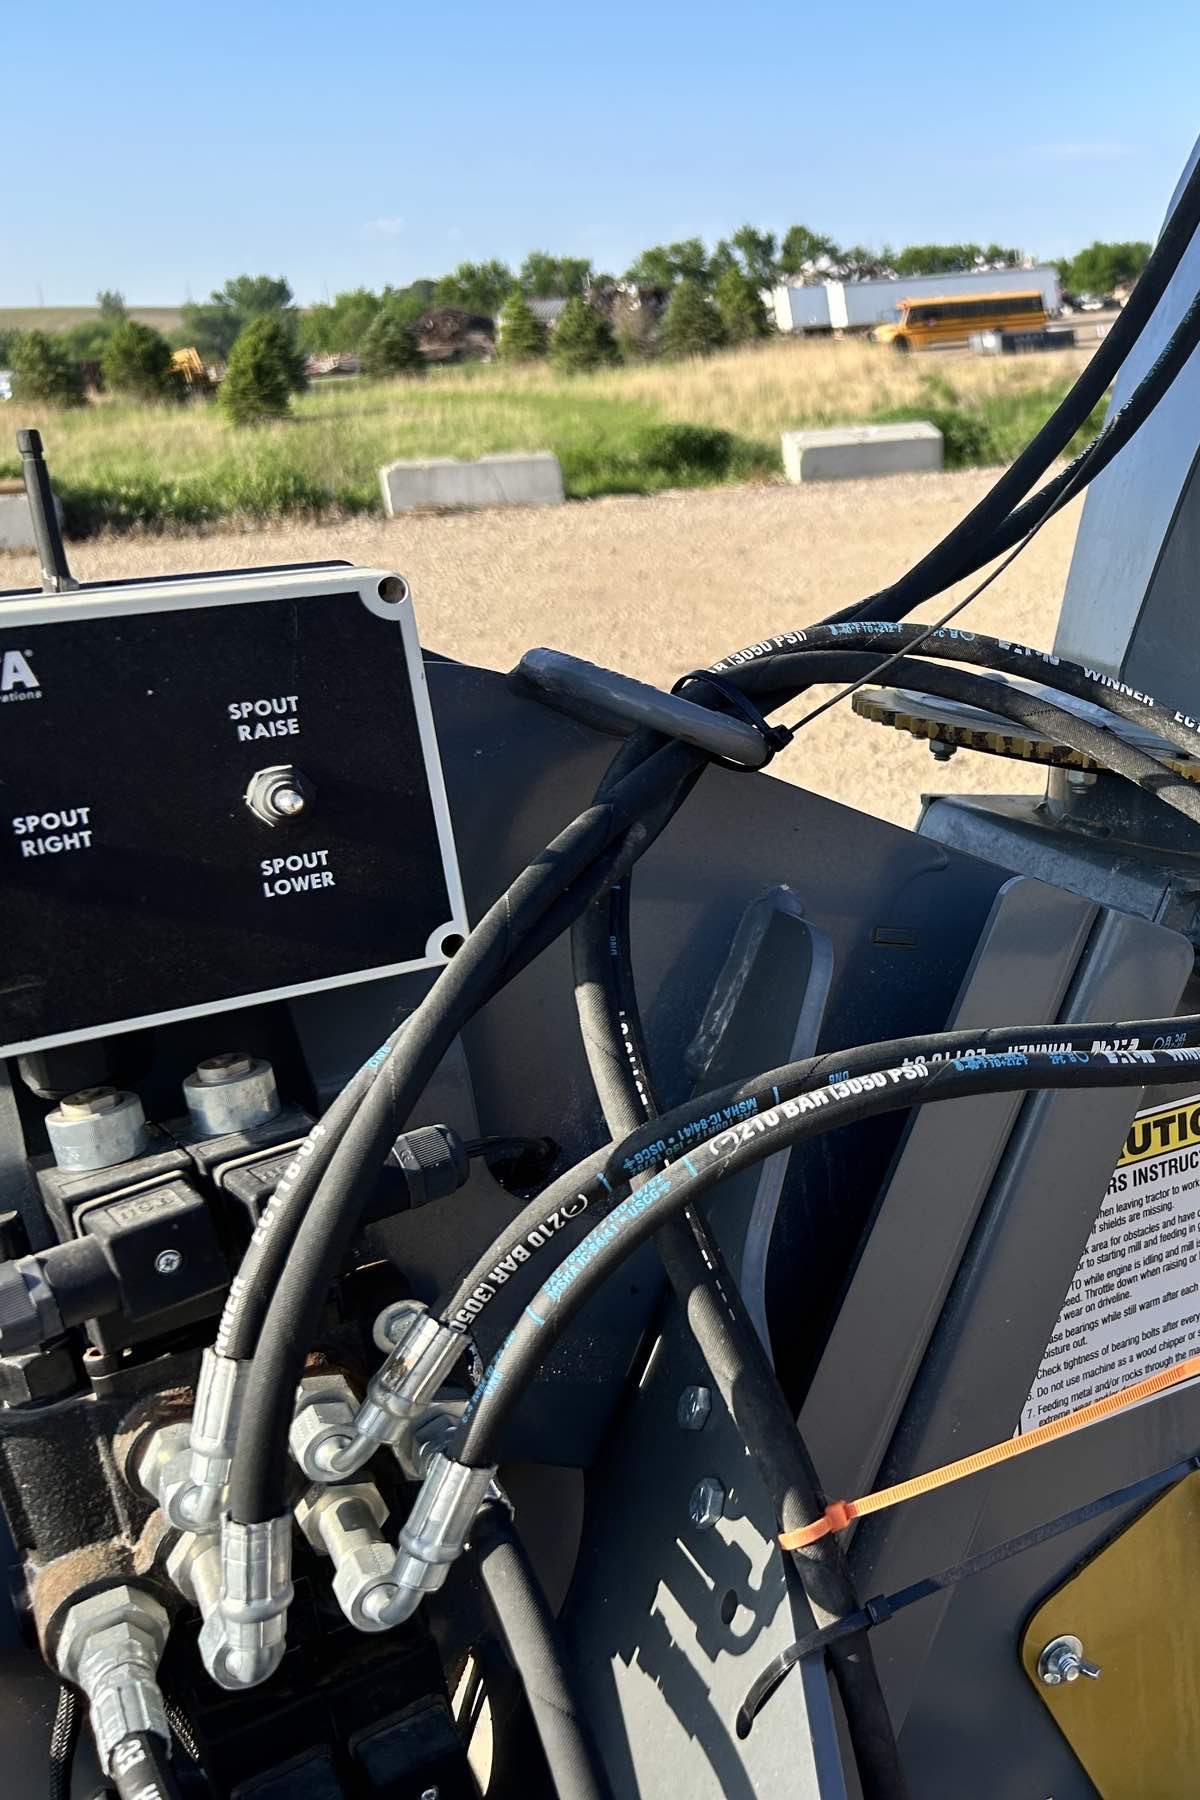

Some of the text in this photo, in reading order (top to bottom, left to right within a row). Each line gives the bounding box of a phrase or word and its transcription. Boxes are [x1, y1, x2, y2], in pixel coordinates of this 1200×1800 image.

[227, 695, 300, 721] SPOUT
[237, 718, 301, 742] RAISE
[12, 807, 91, 835] SPOUT
[21, 830, 93, 857] RIGHT
[260, 850, 330, 877] SPOUT
[263, 871, 336, 898] LOWER
[721, 1096, 758, 1119] MSHA
[780, 1087, 829, 1120] BAR
[828, 1069, 887, 1102] (3050
[888, 1061, 929, 1084] PSI)
[631, 1137, 666, 1164] USCG
[1096, 1206, 1114, 1219] hen
[1115, 1197, 1143, 1213] leaving
[1144, 1188, 1170, 1204] tractor
[1171, 1185, 1179, 1195] to
[1181, 1178, 1200, 1191] work
[1098, 1201, 1174, 1232] shields are missing.
[1085, 1258, 1094, 1268] to
[1096, 1247, 1126, 1264] starting
[1127, 1239, 1141, 1254] mill
[1143, 1234, 1158, 1248] and
[1159, 1226, 1187, 1243] feeding
[1188, 1223, 1196, 1233] in
[1090, 1240, 1108, 1253] area
[1109, 1235, 1121, 1246] for
[1122, 1222, 1160, 1242] obstacles
[1161, 1215, 1176, 1229] and
[1177, 1211, 1195, 1223] have
[486, 1240, 531, 1287] BAR
[1083, 1272, 1104, 1286] while
[1106, 1263, 1132, 1279] engine
[1133, 1260, 1141, 1269] is
[1142, 1252, 1163, 1266] idling
[1164, 1244, 1179, 1258] and
[1180, 1239, 1194, 1253] mill
[1084, 1281, 1114, 1299] Throttle
[1116, 1274, 1138, 1289] down
[1139, 1266, 1160, 1280] when
[1162, 1257, 1187, 1272] raising
[1188, 1253, 1197, 1263] or
[546, 1263, 580, 1301] MSHA
[1063, 1290, 1131, 1320] wear on driveline.
[1064, 1319, 1099, 1338] bearings
[1100, 1310, 1121, 1325] while
[1123, 1303, 1136, 1317] still
[1138, 1296, 1160, 1311] warm
[1161, 1289, 1179, 1303] after
[1180, 1282, 1198, 1296] each
[1036, 1362, 1062, 1380] Check
[1062, 1349, 1099, 1370] tightness
[1100, 1343, 1109, 1355] of
[1111, 1334, 1140, 1352] bearing
[1141, 1327, 1160, 1341] bolts
[1161, 1319, 1178, 1333] after
[1180, 1312, 1200, 1326] every
[1072, 1335, 1087, 1348] out.
[1036, 1386, 1048, 1398] Do
[1050, 1379, 1064, 1392] not
[1065, 1374, 1080, 1387] use
[1081, 1361, 1115, 1380] machine
[1117, 1357, 1127, 1367] as
[1128, 1354, 1133, 1363] a
[1135, 1343, 1156, 1360] wood
[1158, 1334, 1186, 1351] chipper
[1187, 1330, 1195, 1340] or
[1026, 1407, 1035, 1419] 7.
[1037, 1396, 1069, 1415] Feeding
[1070, 1385, 1092, 1402] metal
[1094, 1376, 1120, 1393] and/or
[1121, 1367, 1143, 1382] rocks
[1144, 1355, 1173, 1374] through
[1174, 1351, 1187, 1362] the
